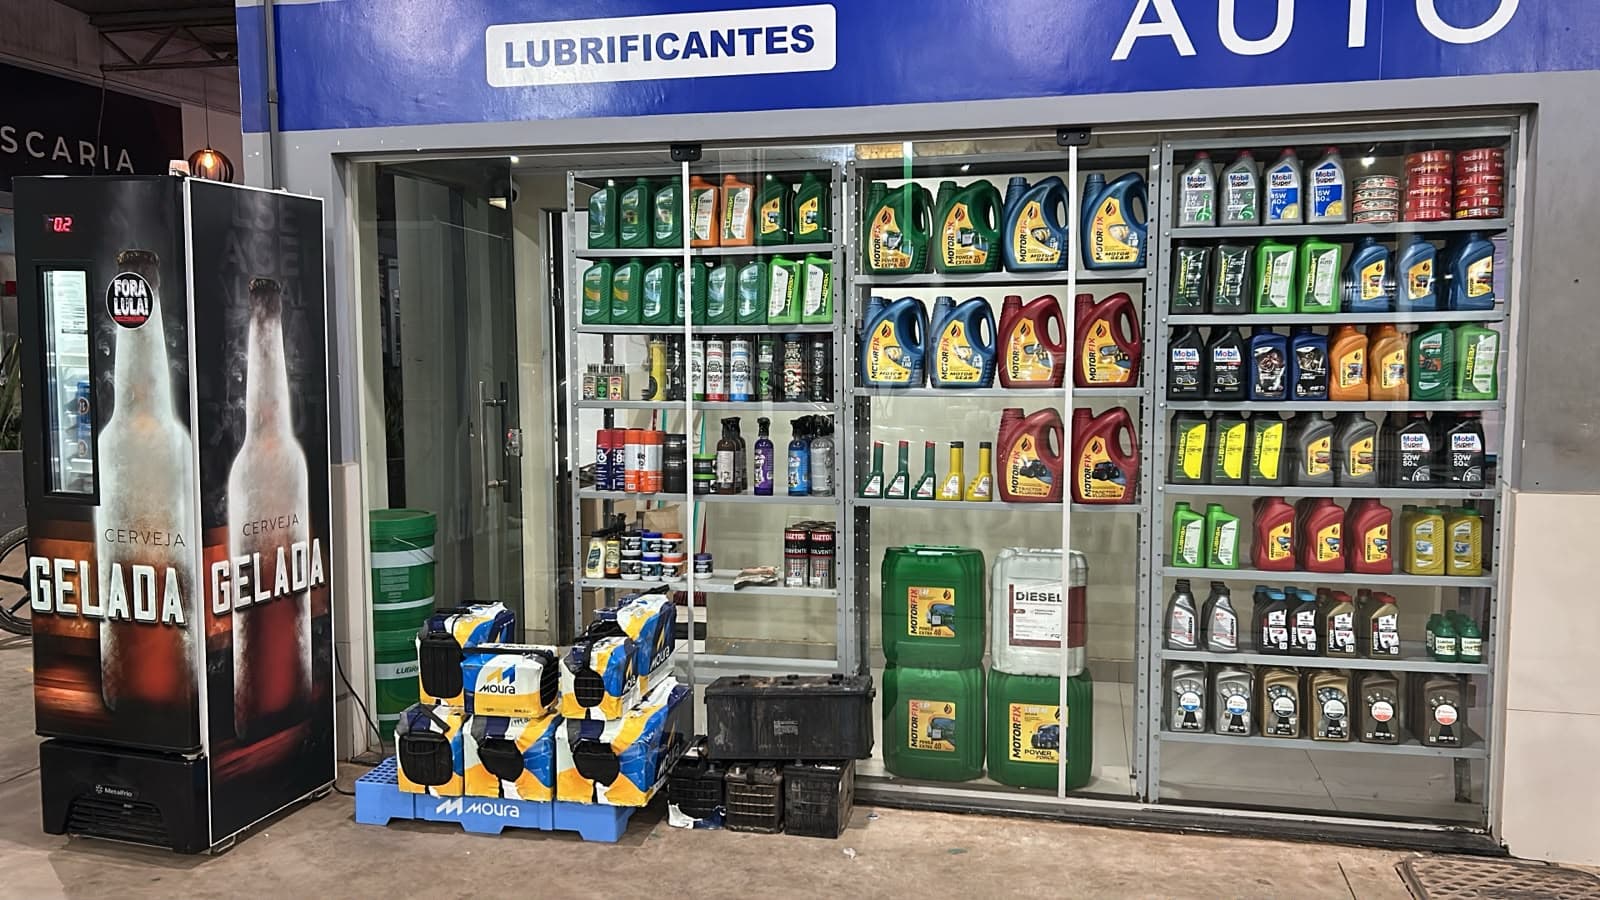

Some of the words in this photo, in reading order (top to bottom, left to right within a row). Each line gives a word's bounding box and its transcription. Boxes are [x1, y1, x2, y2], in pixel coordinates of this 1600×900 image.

[505, 24, 815, 69] LUBRIFICANTES
[114, 279, 148, 298] FORA
[113, 297, 149, 316] LULA!
[1088, 337, 1097, 381] MOTORFIX
[1465, 343, 1476, 380] LUBRAX
[1177, 432, 1187, 466] LUBRAX
[1217, 432, 1227, 466] LUBRAX
[1253, 432, 1262, 466] LUBRAX
[1403, 435, 1423, 443] Mobil
[1454, 435, 1474, 443] Mobil
[1011, 450, 1020, 494] MOTORFIX
[1084, 454, 1093, 497] MOTORFIX
[105, 528, 186, 548] CERVEJA
[242, 513, 300, 537] CERVEJA
[29, 556, 185, 626] GELADA
[211, 538, 326, 616] GELADA
[910, 588, 918, 634] MOTORFIX
[1015, 591, 1063, 603] DIESEL
[911, 701, 919, 748] MOTORFIX
[1012, 705, 1022, 759] MOTORFIX
